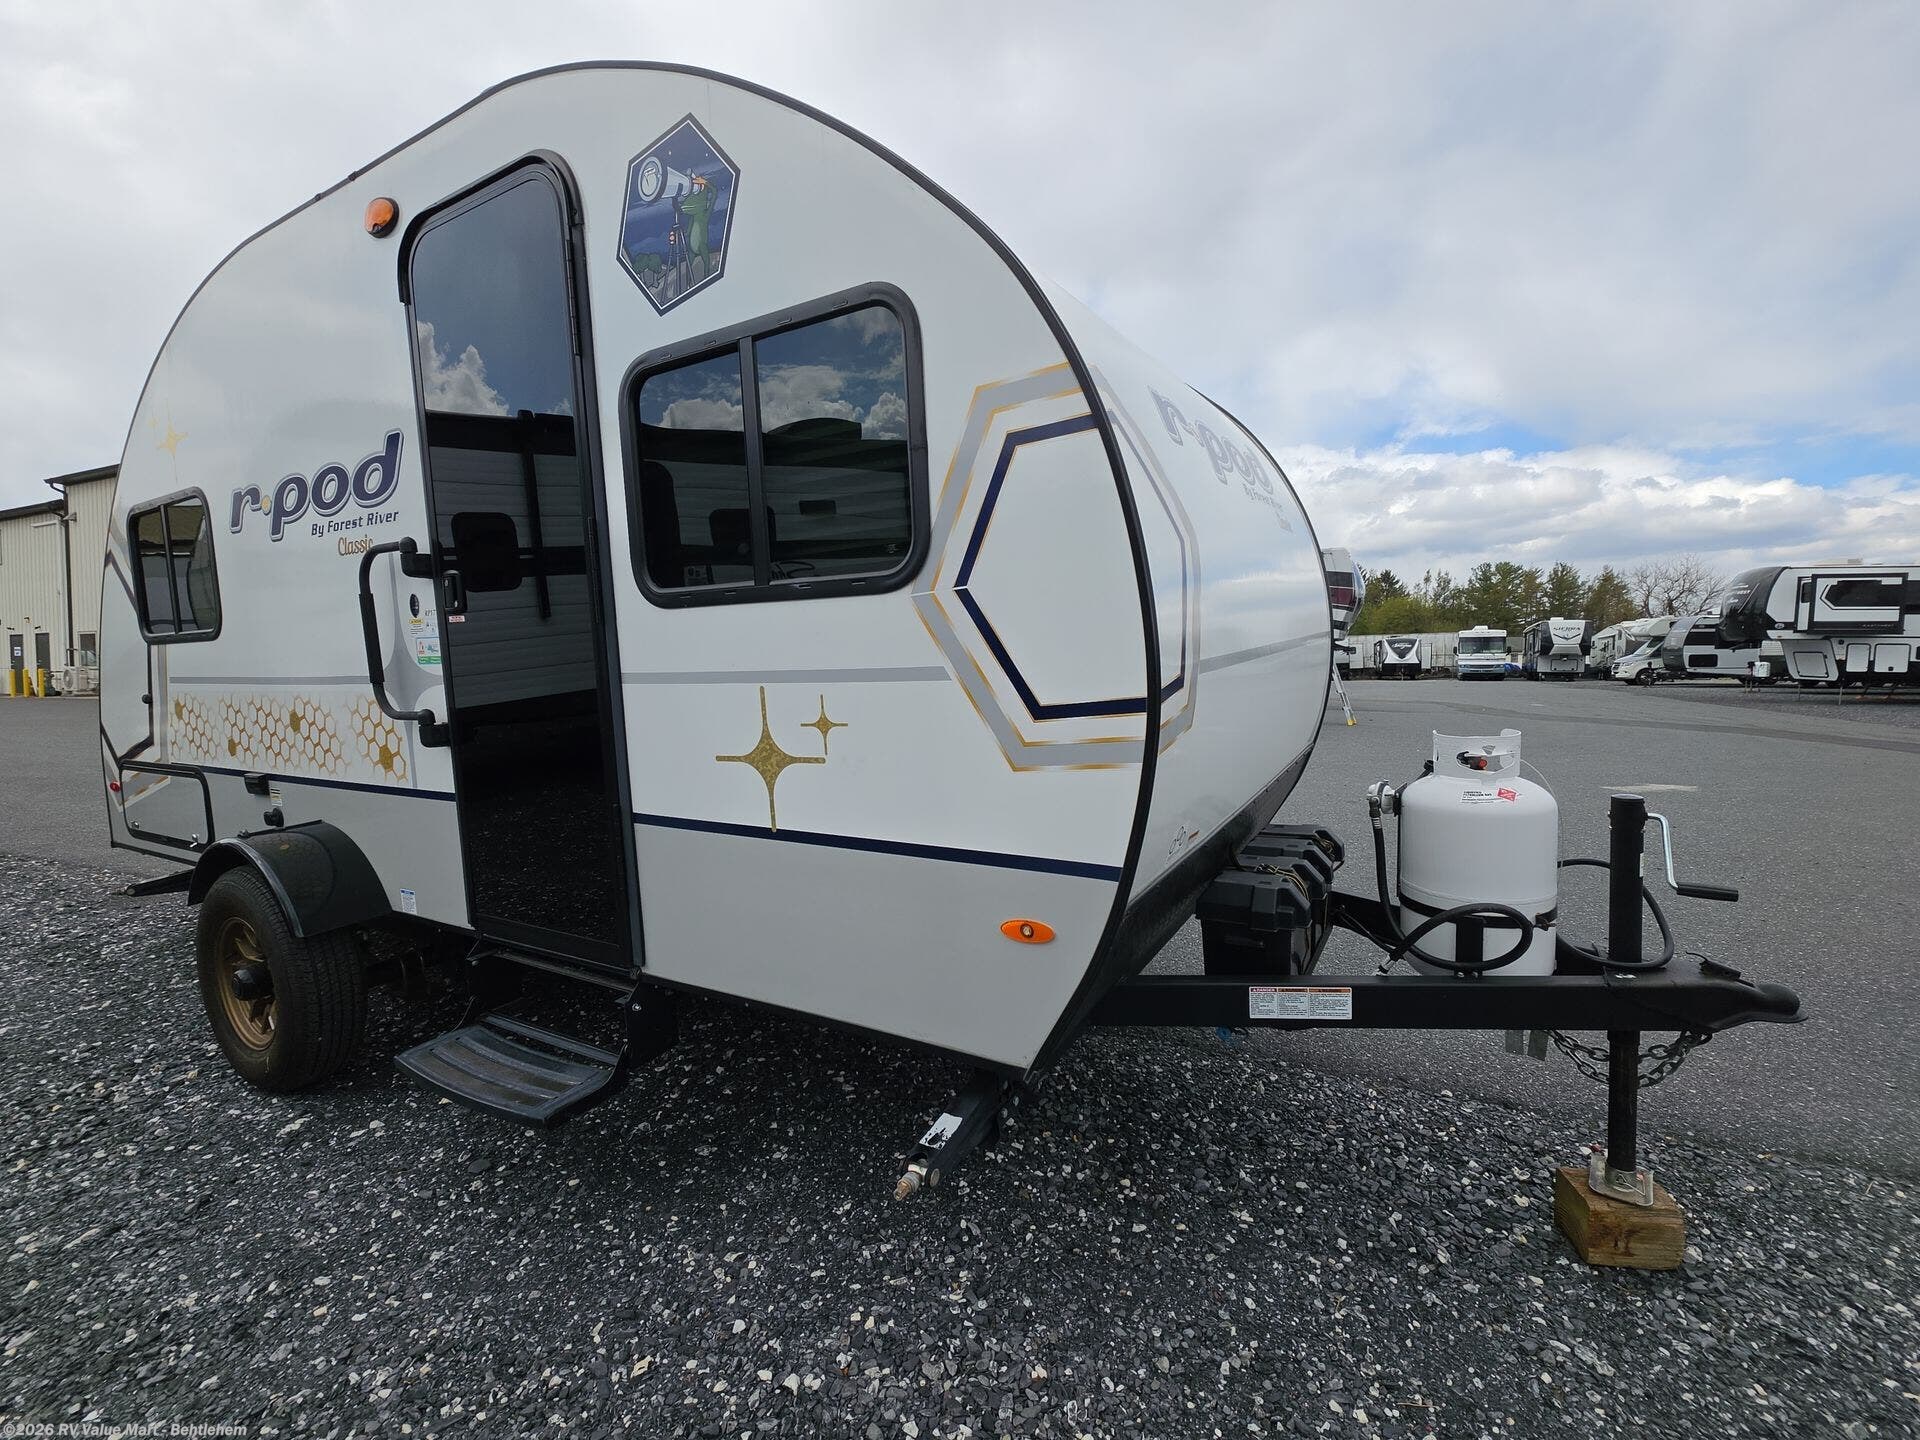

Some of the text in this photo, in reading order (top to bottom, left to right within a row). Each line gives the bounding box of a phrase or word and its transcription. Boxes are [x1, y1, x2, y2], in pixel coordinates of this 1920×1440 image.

[311, 511, 399, 537] By Forest River
[338, 534, 373, 556] Classic
